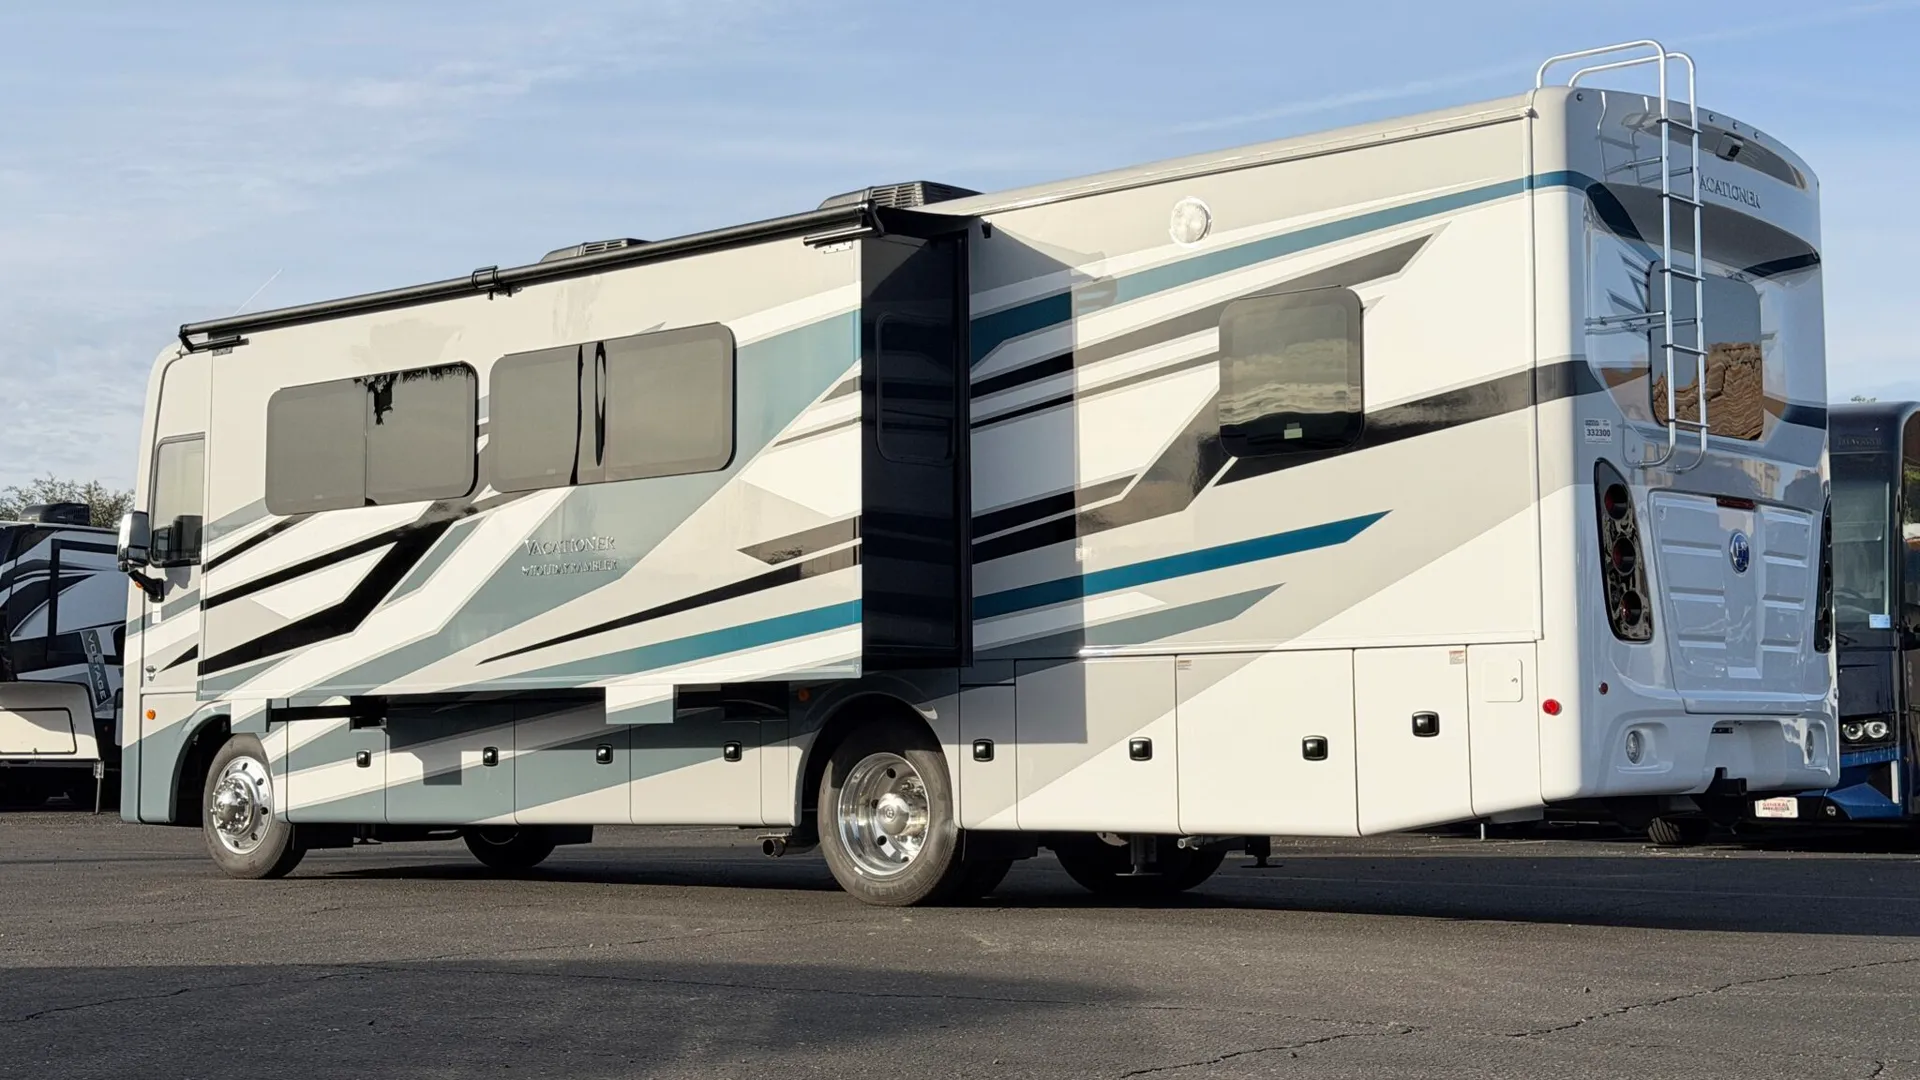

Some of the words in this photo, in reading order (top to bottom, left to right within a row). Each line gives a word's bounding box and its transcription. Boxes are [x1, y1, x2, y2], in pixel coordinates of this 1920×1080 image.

[1700, 174, 1761, 209] ACATIONER
[1586, 428, 1611, 437] 332300
[522, 536, 616, 556] VACATIONER
[88, 632, 107, 700] VOLTAGE
